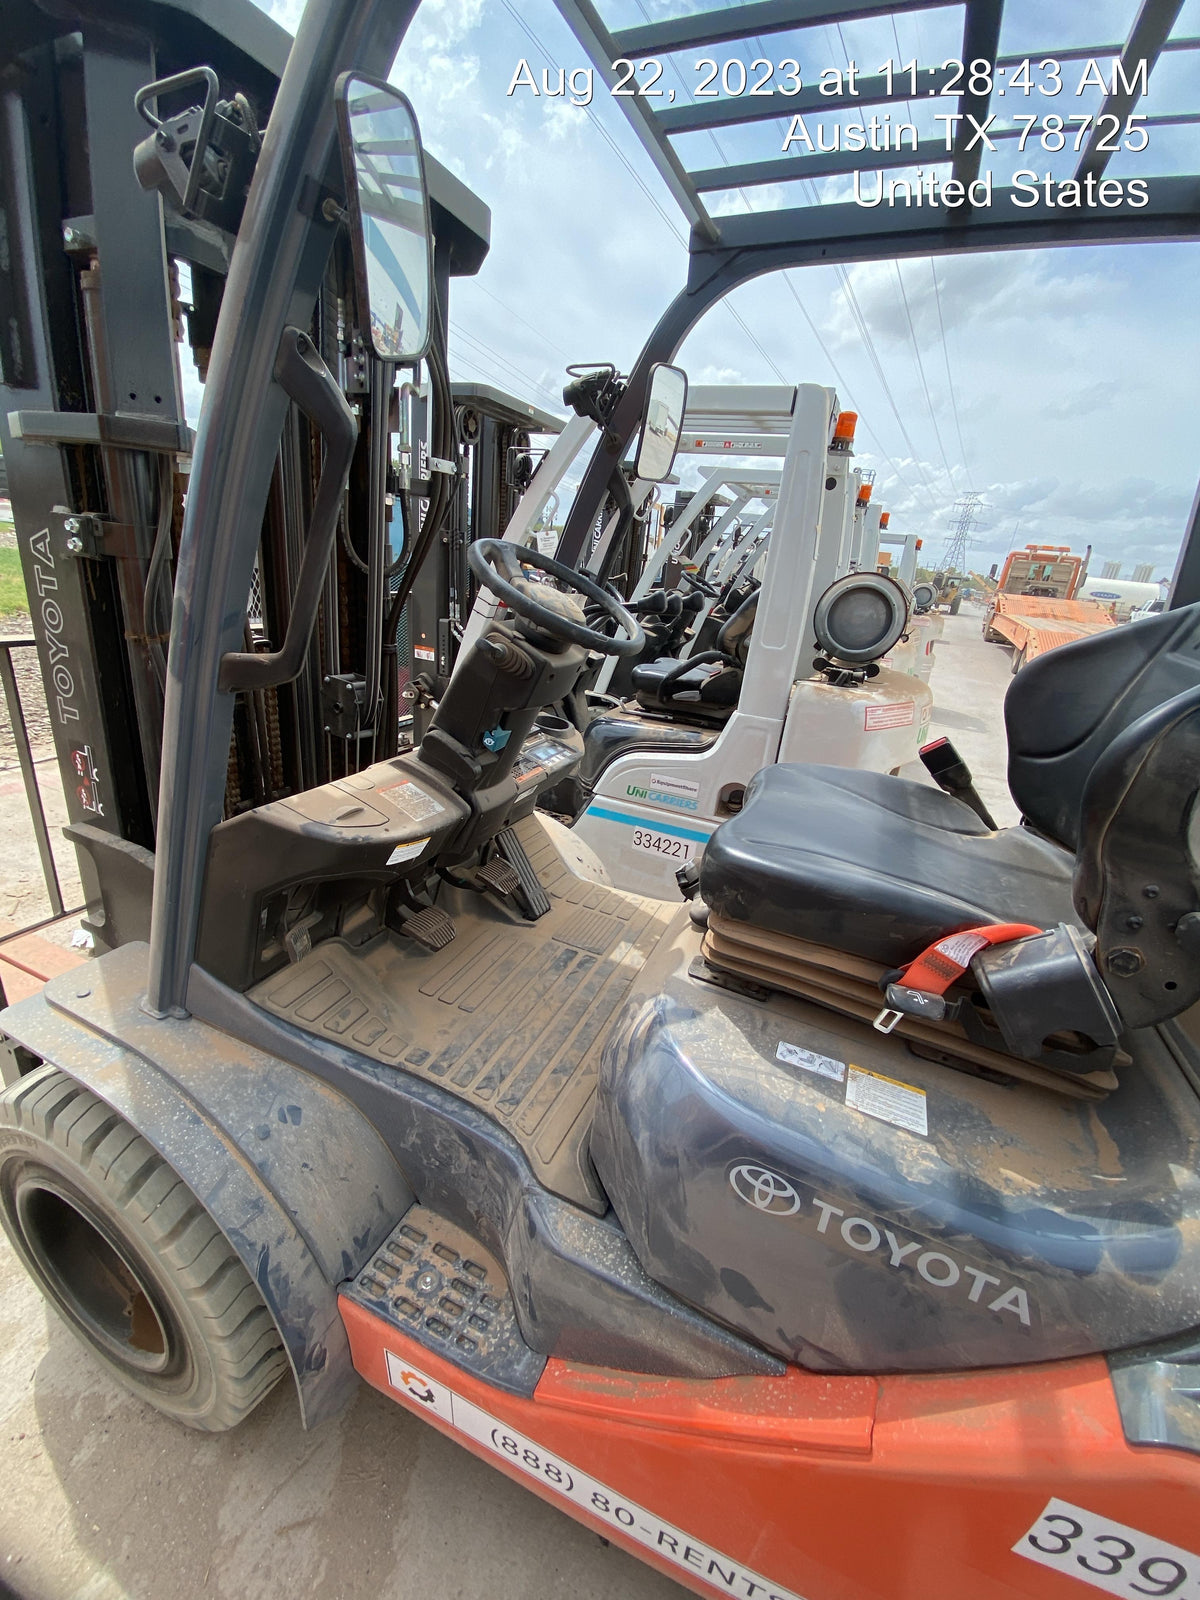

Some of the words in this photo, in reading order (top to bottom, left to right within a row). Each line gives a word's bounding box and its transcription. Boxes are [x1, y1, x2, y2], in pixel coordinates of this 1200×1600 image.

[30, 528, 79, 724] TOYOTA
[633, 830, 690, 860] 334221
[812, 1197, 1031, 1326] TOYOTA
[491, 1428, 574, 1492] (888)
[1028, 1514, 1200, 1600] 339
